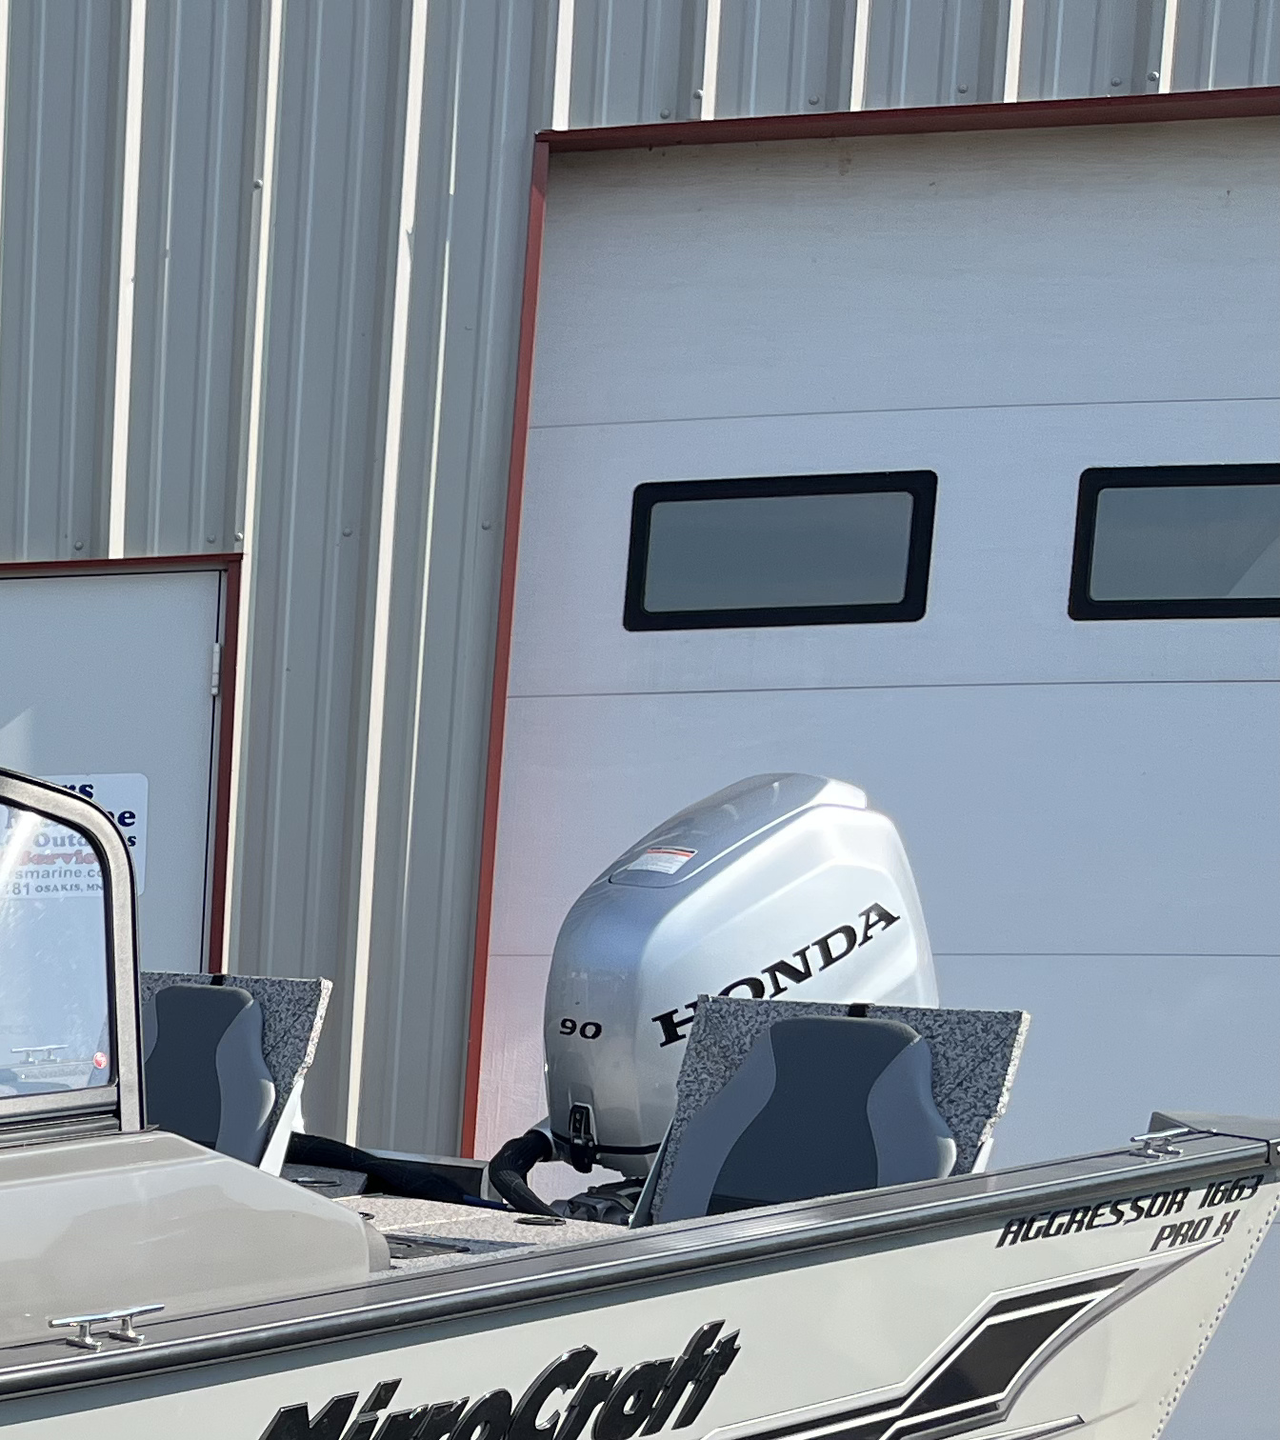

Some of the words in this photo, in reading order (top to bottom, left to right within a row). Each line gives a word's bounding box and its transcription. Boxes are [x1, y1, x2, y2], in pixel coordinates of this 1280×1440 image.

[559, 1018, 603, 1040] 90
[995, 1187, 1191, 1249] AGGRESSOR
[1197, 1174, 1264, 1210] 1663
[1149, 1216, 1214, 1252] PRO
[1212, 1209, 1241, 1237] X
